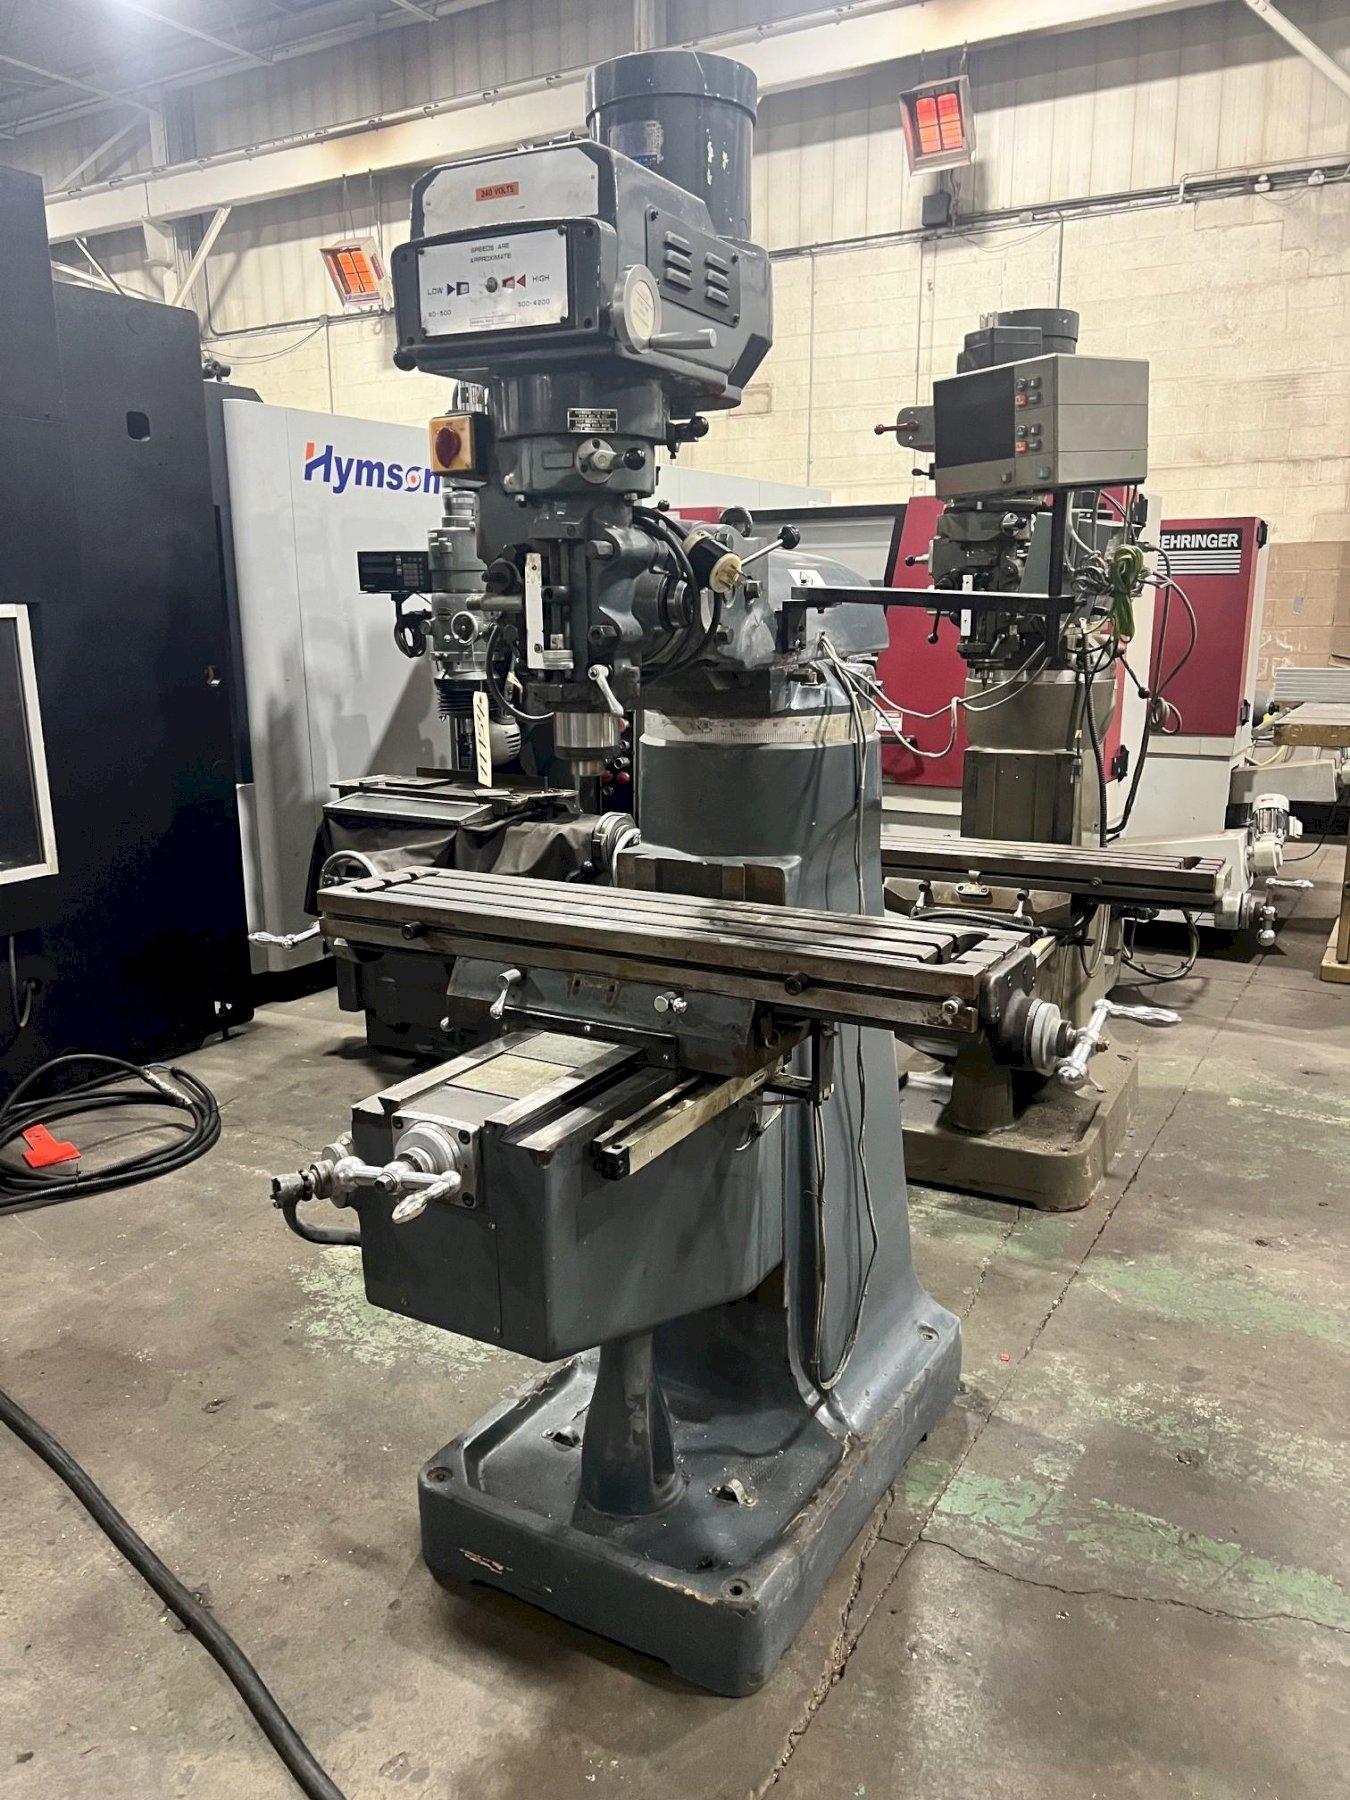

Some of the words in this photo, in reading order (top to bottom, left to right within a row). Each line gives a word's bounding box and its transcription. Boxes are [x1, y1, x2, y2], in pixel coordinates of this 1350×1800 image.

[470, 245, 494, 253] SPEEDS
[497, 242, 510, 250] ARE
[470, 253, 512, 263] APPROXIMATE
[532, 274, 550, 283] HIGH
[427, 287, 443, 296] LOW
[304, 442, 440, 494] Hymson
[1160, 533, 1239, 549] EHRINGER
